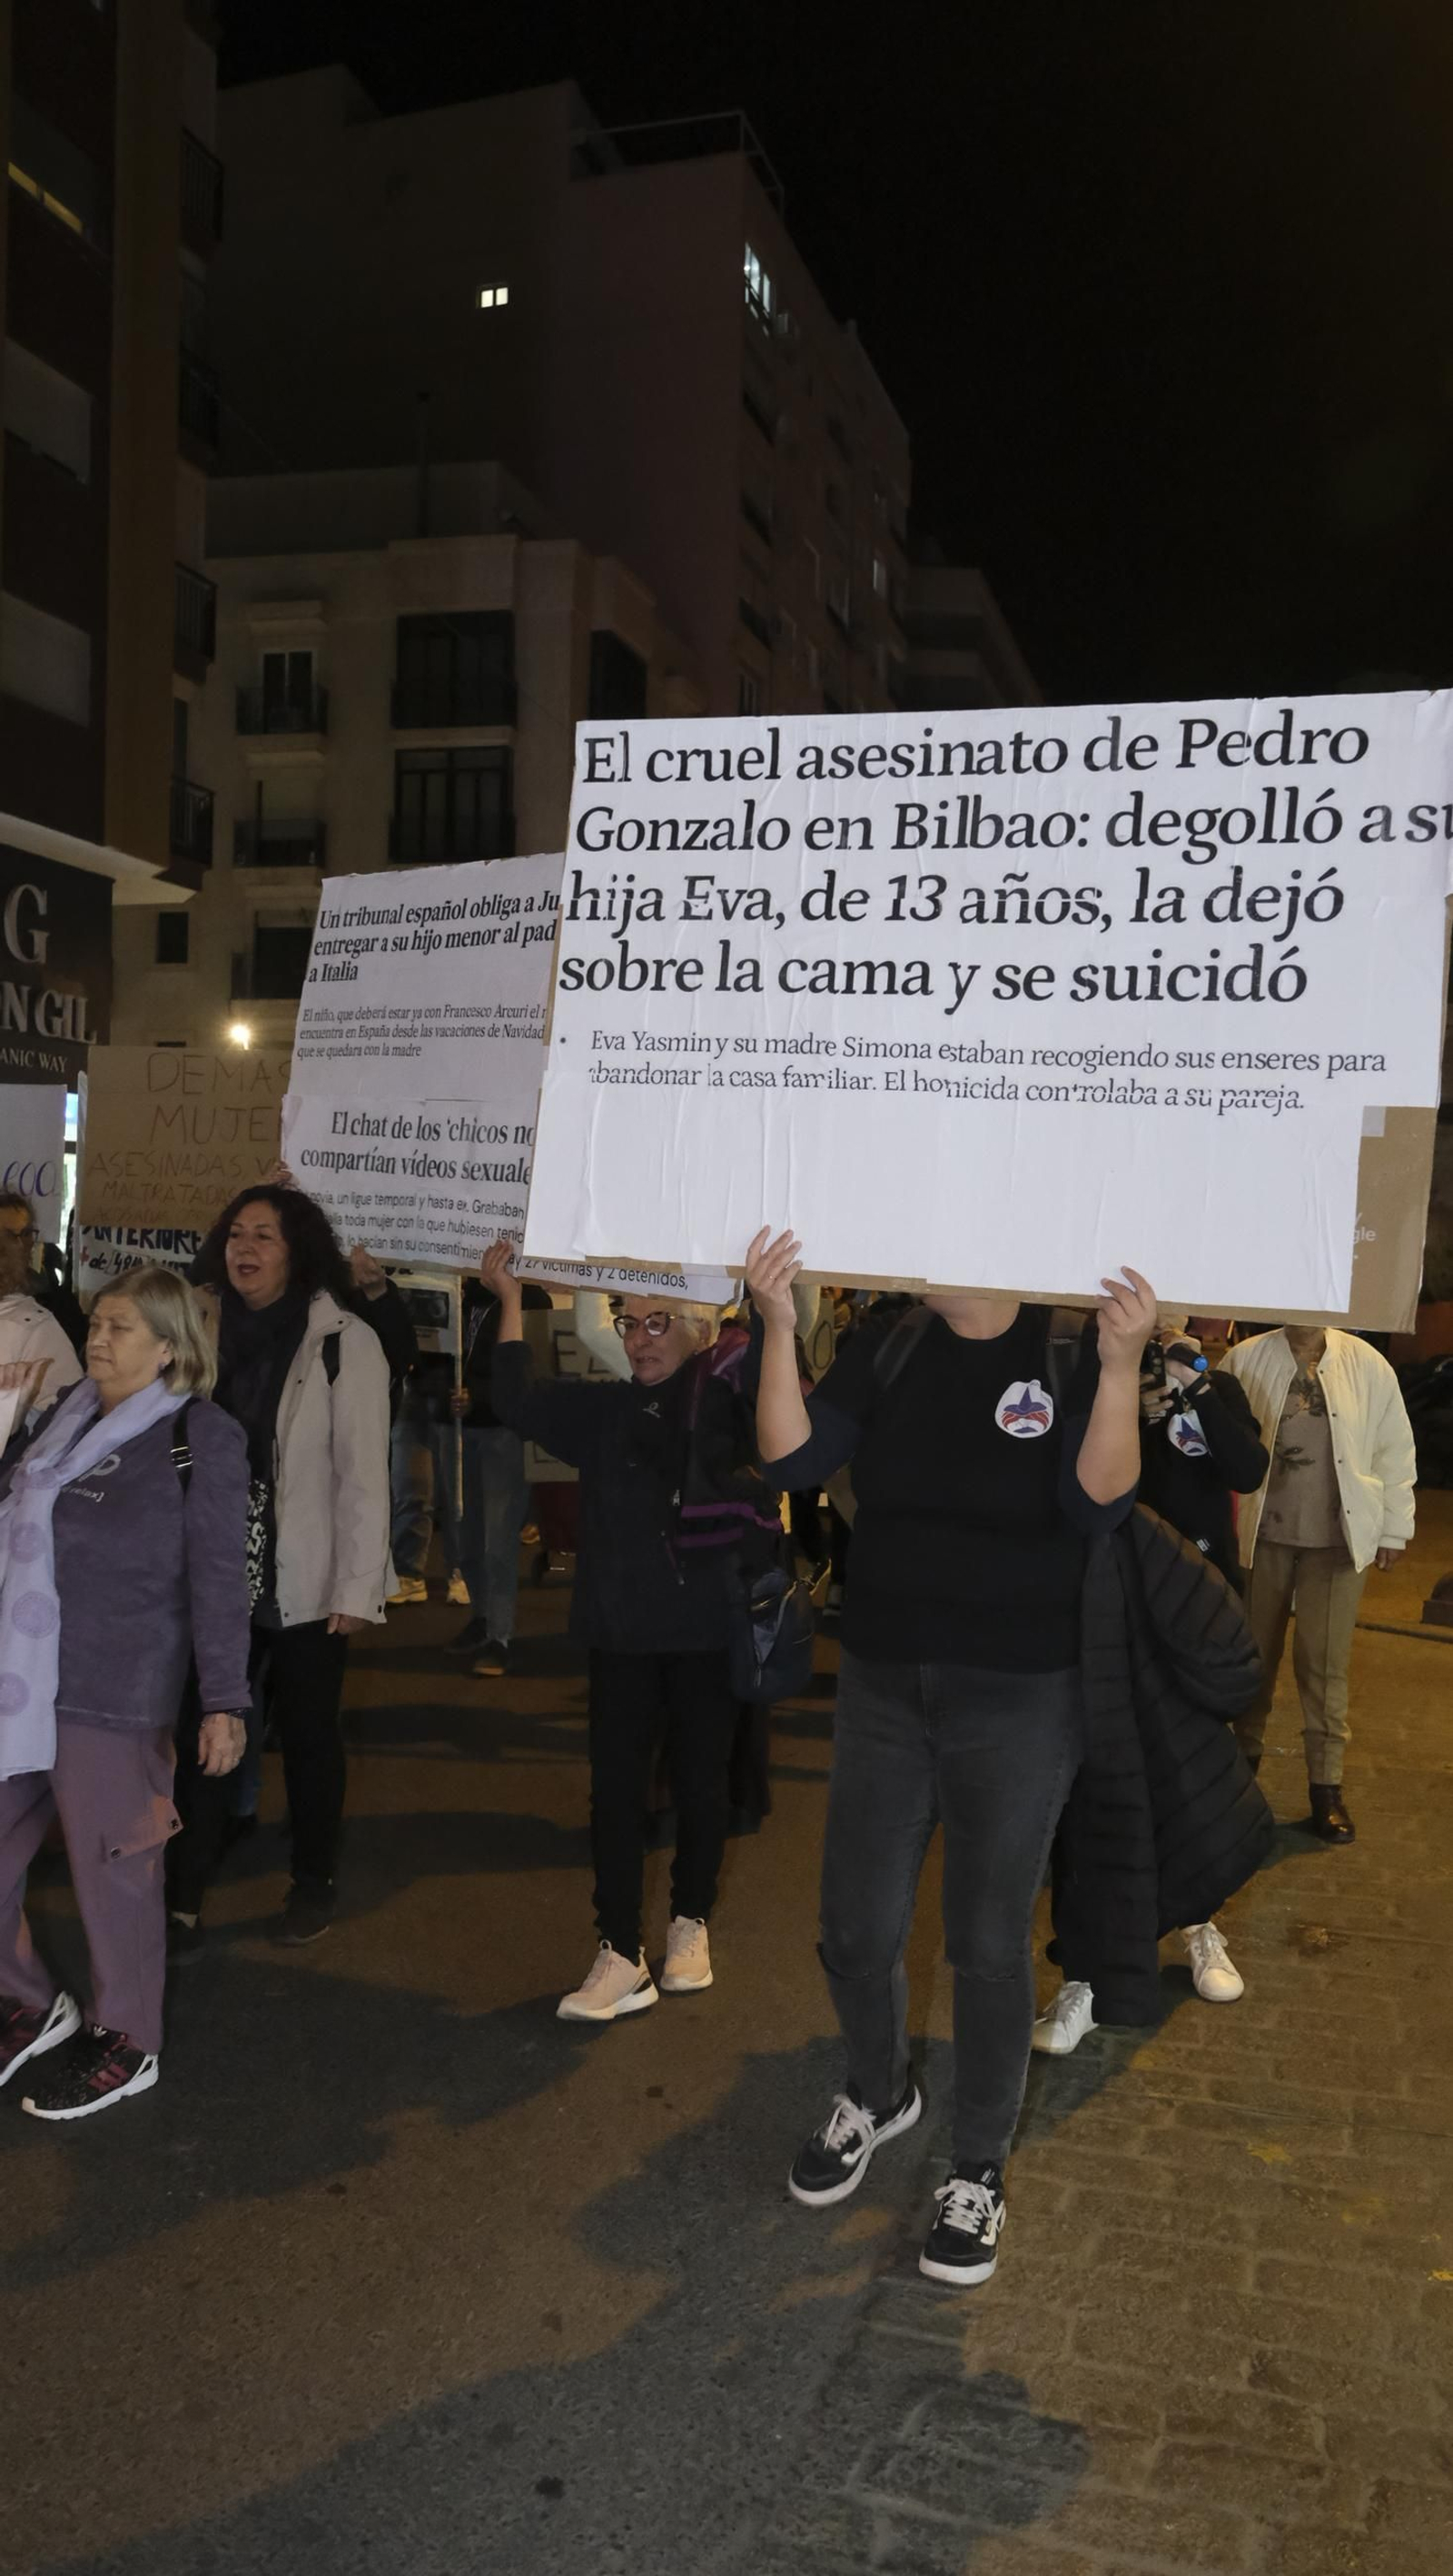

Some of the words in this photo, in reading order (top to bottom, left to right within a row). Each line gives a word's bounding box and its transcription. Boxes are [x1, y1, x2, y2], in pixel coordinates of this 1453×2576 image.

[583, 731, 631, 782] El
[647, 728, 781, 782] cruel
[796, 728, 1068, 779] asesinato
[1084, 717, 1158, 771] de
[1176, 708, 1369, 768] Pedro
[577, 799, 790, 851] Gonzalo
[805, 817, 874, 850] en
[891, 795, 1090, 849] Bilbao:
[1106, 787, 1342, 864] degolló
[1359, 806, 1396, 843] a
[319, 909, 341, 930] Un
[341, 902, 405, 926] tribunal
[405, 896, 469, 928] español
[469, 891, 521, 923] obliga
[523, 894, 536, 913] a
[566, 870, 666, 938] hija
[679, 876, 785, 930] Eva,
[801, 869, 870, 921] de
[885, 875, 946, 921] 13
[960, 872, 1112, 933] años,
[1130, 867, 1186, 923] la
[1203, 865, 1343, 942] dejó
[4, 884, 50, 964] G
[313, 937, 382, 960] entregar
[380, 938, 389, 953] a
[390, 934, 410, 954] su
[410, 928, 442, 956] hijo
[443, 926, 502, 949] menor
[502, 923, 519, 945] al
[520, 917, 558, 950] pad
[308, 966, 318, 983] a
[320, 960, 358, 982] Italia
[558, 939, 704, 992] sobre
[716, 940, 763, 992] la
[778, 959, 934, 996] cama
[944, 963, 981, 1015] y
[993, 965, 1054, 1001] se
[1070, 942, 1307, 1002] suicidó
[300, 1025, 344, 1040] encuentra
[345, 1025, 357, 1039] en
[359, 1025, 390, 1043] España
[391, 1024, 419, 1039] desde
[420, 1024, 434, 1038] las
[435, 1023, 486, 1038] vacaciones
[487, 1023, 499, 1038] de
[501, 1023, 545, 1039] Navidad
[301, 1008, 314, 1023] El
[337, 1010, 355, 1027] que
[356, 1005, 388, 1022] deberá
[388, 1005, 411, 1021] estar
[411, 1008, 423, 1025] ya
[424, 1008, 441, 1019] con
[443, 1004, 491, 1019] Francesco
[493, 1003, 529, 1019] Arcuri
[529, 1004, 540, 1019] el
[38, 1052, 68, 1074] WAY
[297, 1047, 315, 1059] que
[315, 1047, 324, 1058] se
[363, 1046, 381, 1056] con
[381, 1044, 390, 1056] la
[391, 1044, 422, 1056] madre
[592, 1031, 625, 1050] Eva
[632, 1031, 710, 1052] Yasmin
[714, 1038, 728, 1059] y
[734, 1038, 757, 1053] su
[765, 1032, 836, 1056] madre
[843, 1036, 931, 1058] Simona
[939, 1040, 1023, 1064] estaban
[1032, 1044, 1169, 1074] recogiendo
[1175, 1052, 1215, 1068] sus
[1221, 1053, 1320, 1070] enseres
[1327, 1055, 1386, 1079] para
[729, 1071, 776, 1086] casa
[885, 1070, 905, 1091] El
[1165, 1088, 1178, 1105] a
[1184, 1089, 1211, 1106] su
[1218, 1085, 1303, 1116] pareja.
[149, 1104, 282, 1144] MUJE
[331, 1111, 349, 1135] El
[349, 1112, 389, 1139] chat
[391, 1115, 414, 1141] de
[416, 1115, 441, 1142] los
[301, 1144, 397, 1175] compartían
[400, 1148, 459, 1180] vídeos
[336, 1194, 350, 1206] un
[351, 1191, 372, 1209] ligue
[374, 1194, 417, 1211] temporal
[418, 1197, 427, 1211] y
[427, 1195, 454, 1211] hasta
[471, 1199, 525, 1220] Grababan
[344, 1213, 365, 1226] toda
[367, 1215, 395, 1232] mujer
[396, 1217, 414, 1229] con
[416, 1216, 426, 1230] la
[427, 1221, 446, 1234] que
[447, 1221, 494, 1239] hubiesen
[389, 1234, 403, 1251] sin
[404, 1240, 418, 1252] su
[596, 1267, 606, 1282] y
